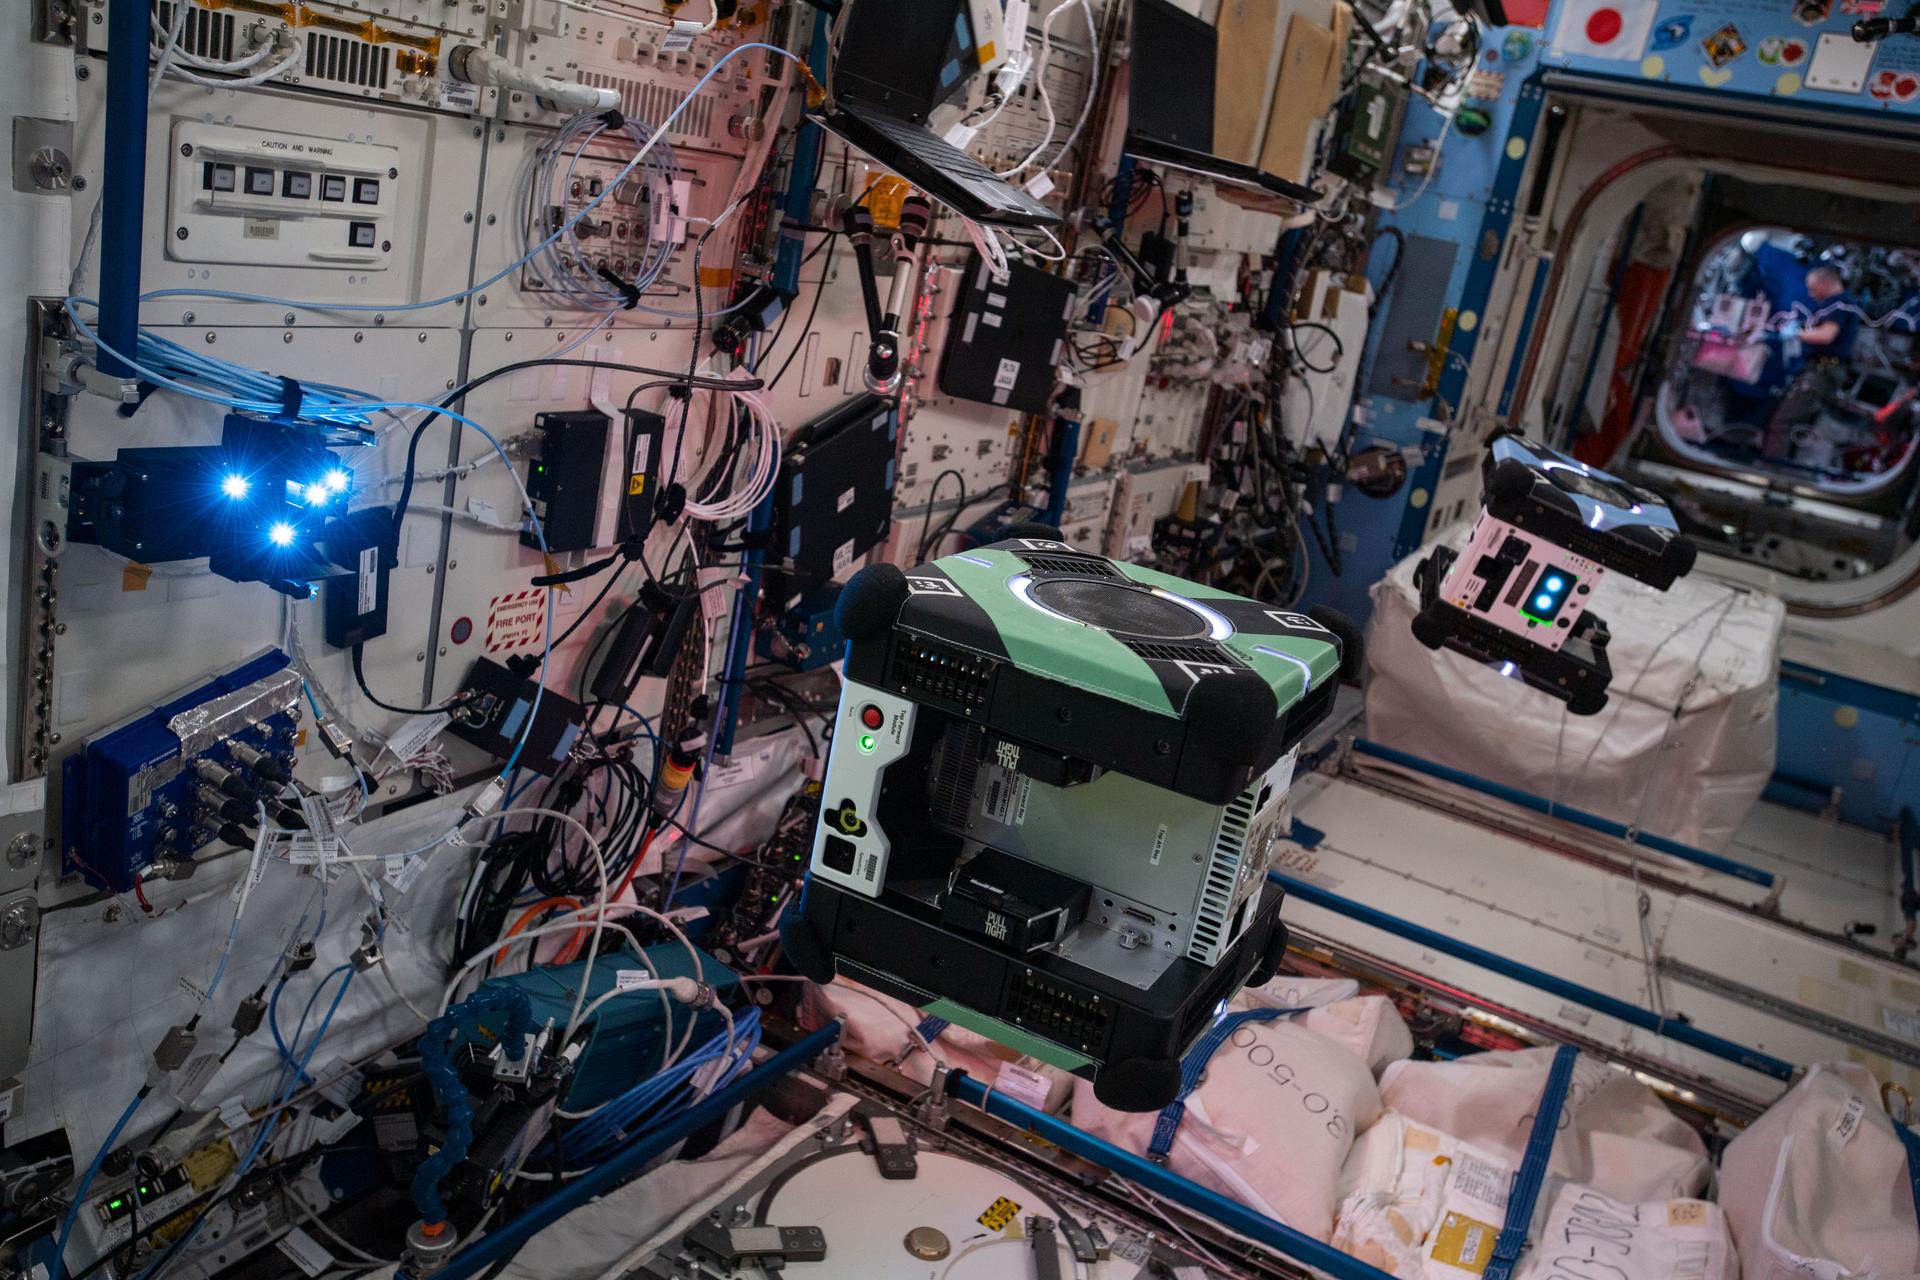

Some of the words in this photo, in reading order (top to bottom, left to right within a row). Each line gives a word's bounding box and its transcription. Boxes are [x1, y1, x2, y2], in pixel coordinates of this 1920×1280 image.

[261, 139, 288, 151] CAUTION
[292, 143, 304, 153] AND
[308, 146, 333, 156] WARNING
[496, 601, 528, 613] EMERGENCY
[495, 616, 513, 630] FIRE
[515, 612, 537, 625] PORT
[899, 709, 907, 719] Top
[890, 714, 899, 735] Module
[896, 720, 905, 745] Forward
[996, 740, 1021, 760] TIGHT
[996, 752, 1018, 770] PULL
[1022, 786, 1031, 809] Forward
[987, 910, 1007, 927] PULL
[984, 920, 1008, 940] TIGHT
